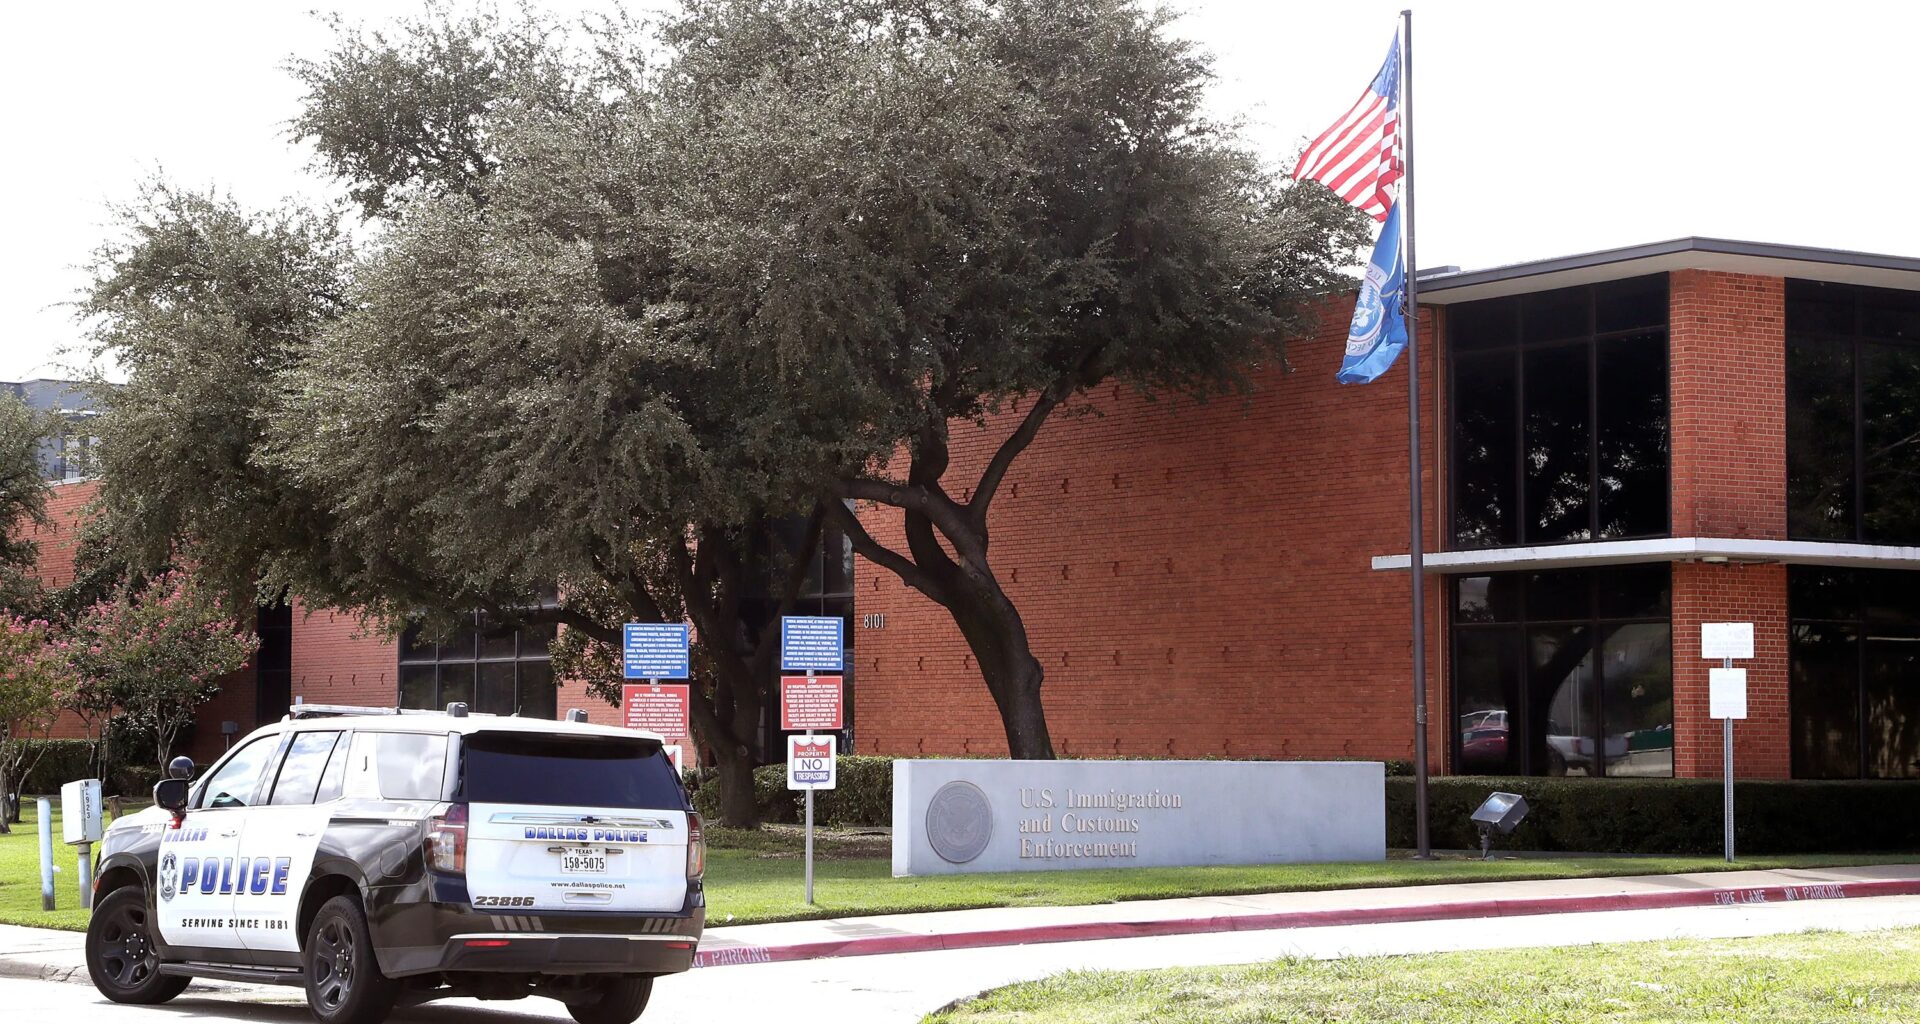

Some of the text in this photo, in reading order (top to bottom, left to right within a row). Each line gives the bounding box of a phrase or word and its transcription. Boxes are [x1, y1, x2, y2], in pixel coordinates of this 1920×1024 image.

[863, 613, 884, 629] 8101
[801, 758, 823, 770] NO
[796, 772, 828, 780] TRESPASSING
[1019, 787, 1182, 812] U.S. Immigration
[1019, 812, 1139, 833] and Customs
[164, 828, 208, 842] DALLAS
[524, 826, 648, 842] DALLAS POLICE
[1019, 838, 1137, 859] Enforcement
[180, 856, 291, 895] POLICE
[551, 881, 626, 889] www.dallaspolice.net
[474, 895, 535, 906] 23886
[1714, 891, 1735, 904] FIRE
[1740, 889, 1766, 904] LANE
[1802, 884, 1845, 900] PARKING
[182, 918, 288, 930] SERVING SINCE 1881
[712, 947, 770, 966] PARKING
